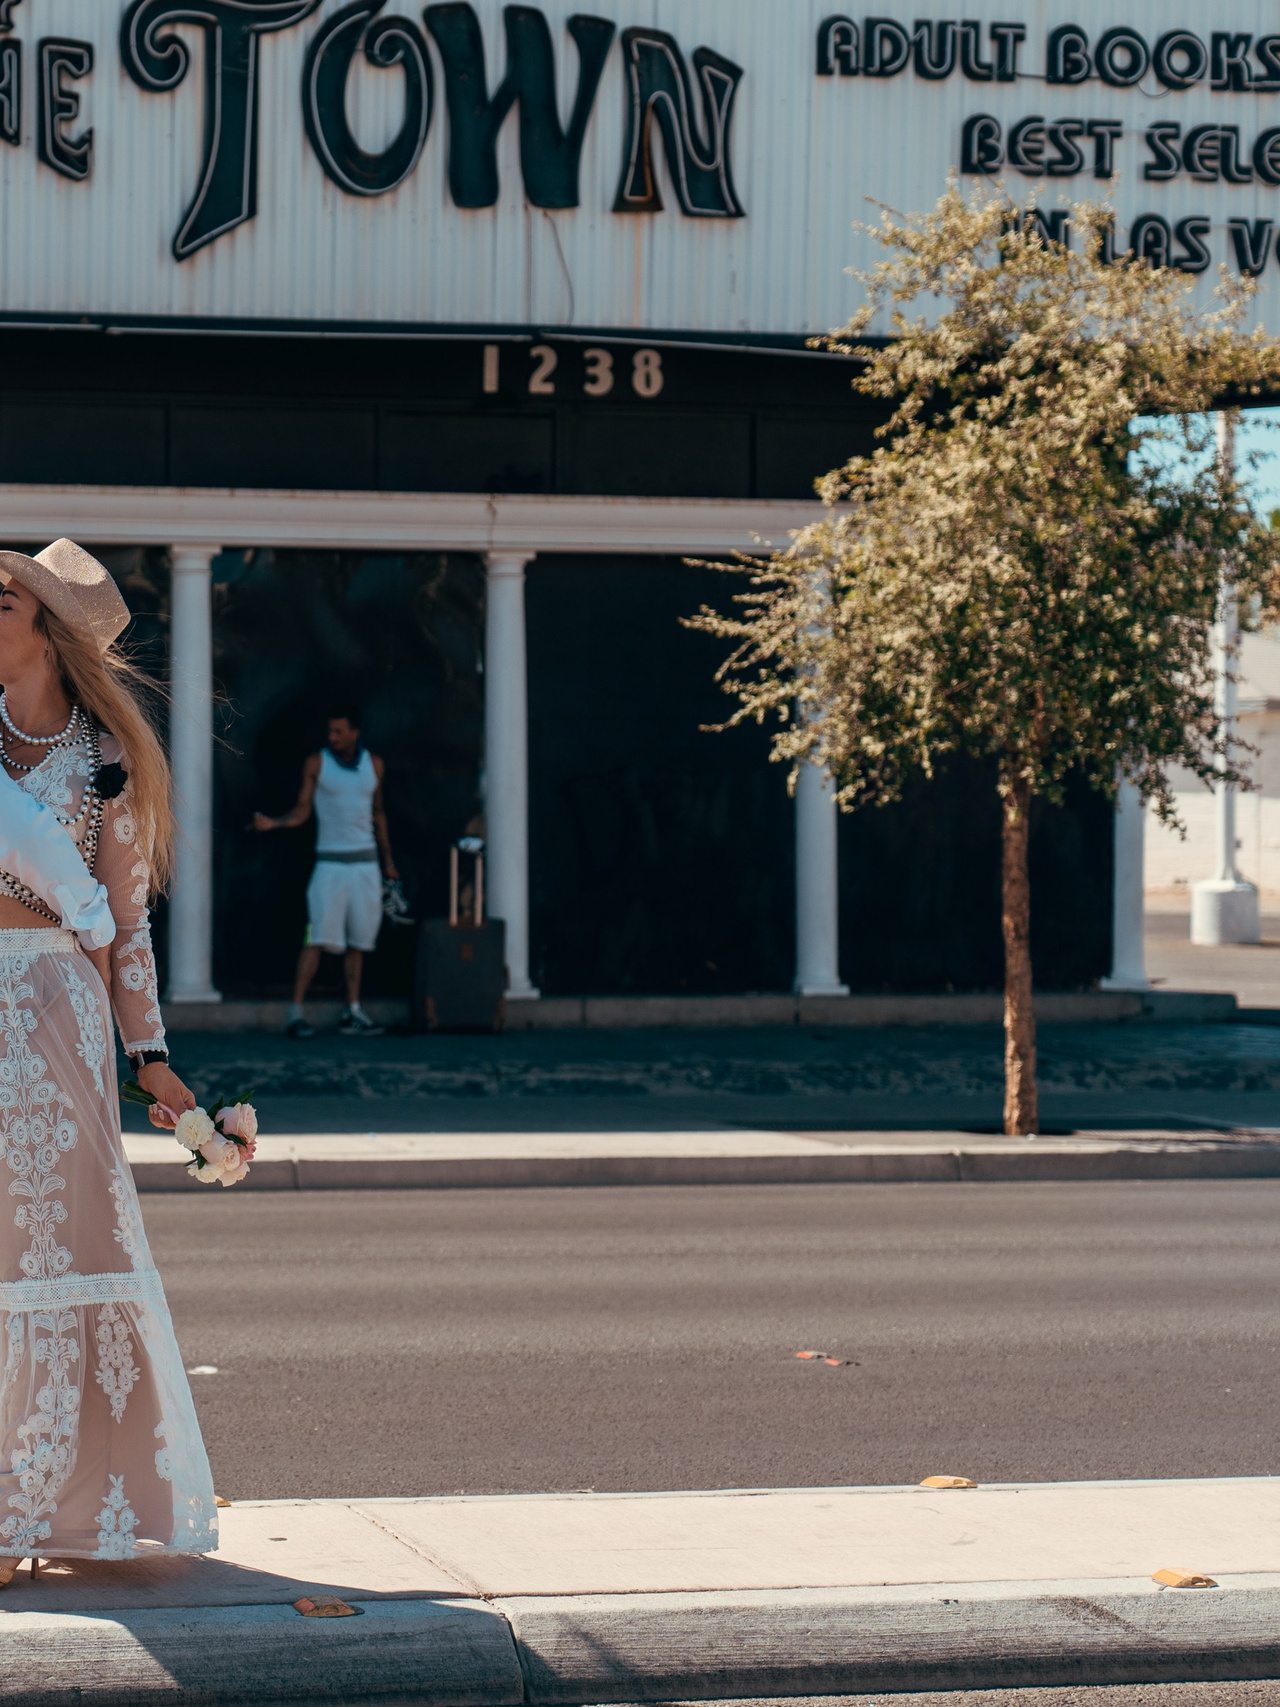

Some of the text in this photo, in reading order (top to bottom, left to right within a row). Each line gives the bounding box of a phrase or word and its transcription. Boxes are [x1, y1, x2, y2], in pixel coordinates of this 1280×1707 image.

[816, 14, 1280, 92] ADULT BOOKS
[119, 0, 746, 262] TOWN
[961, 113, 1122, 178] BEST
[1096, 213, 1211, 274] LAS
[483, 345, 664, 398] 1238
